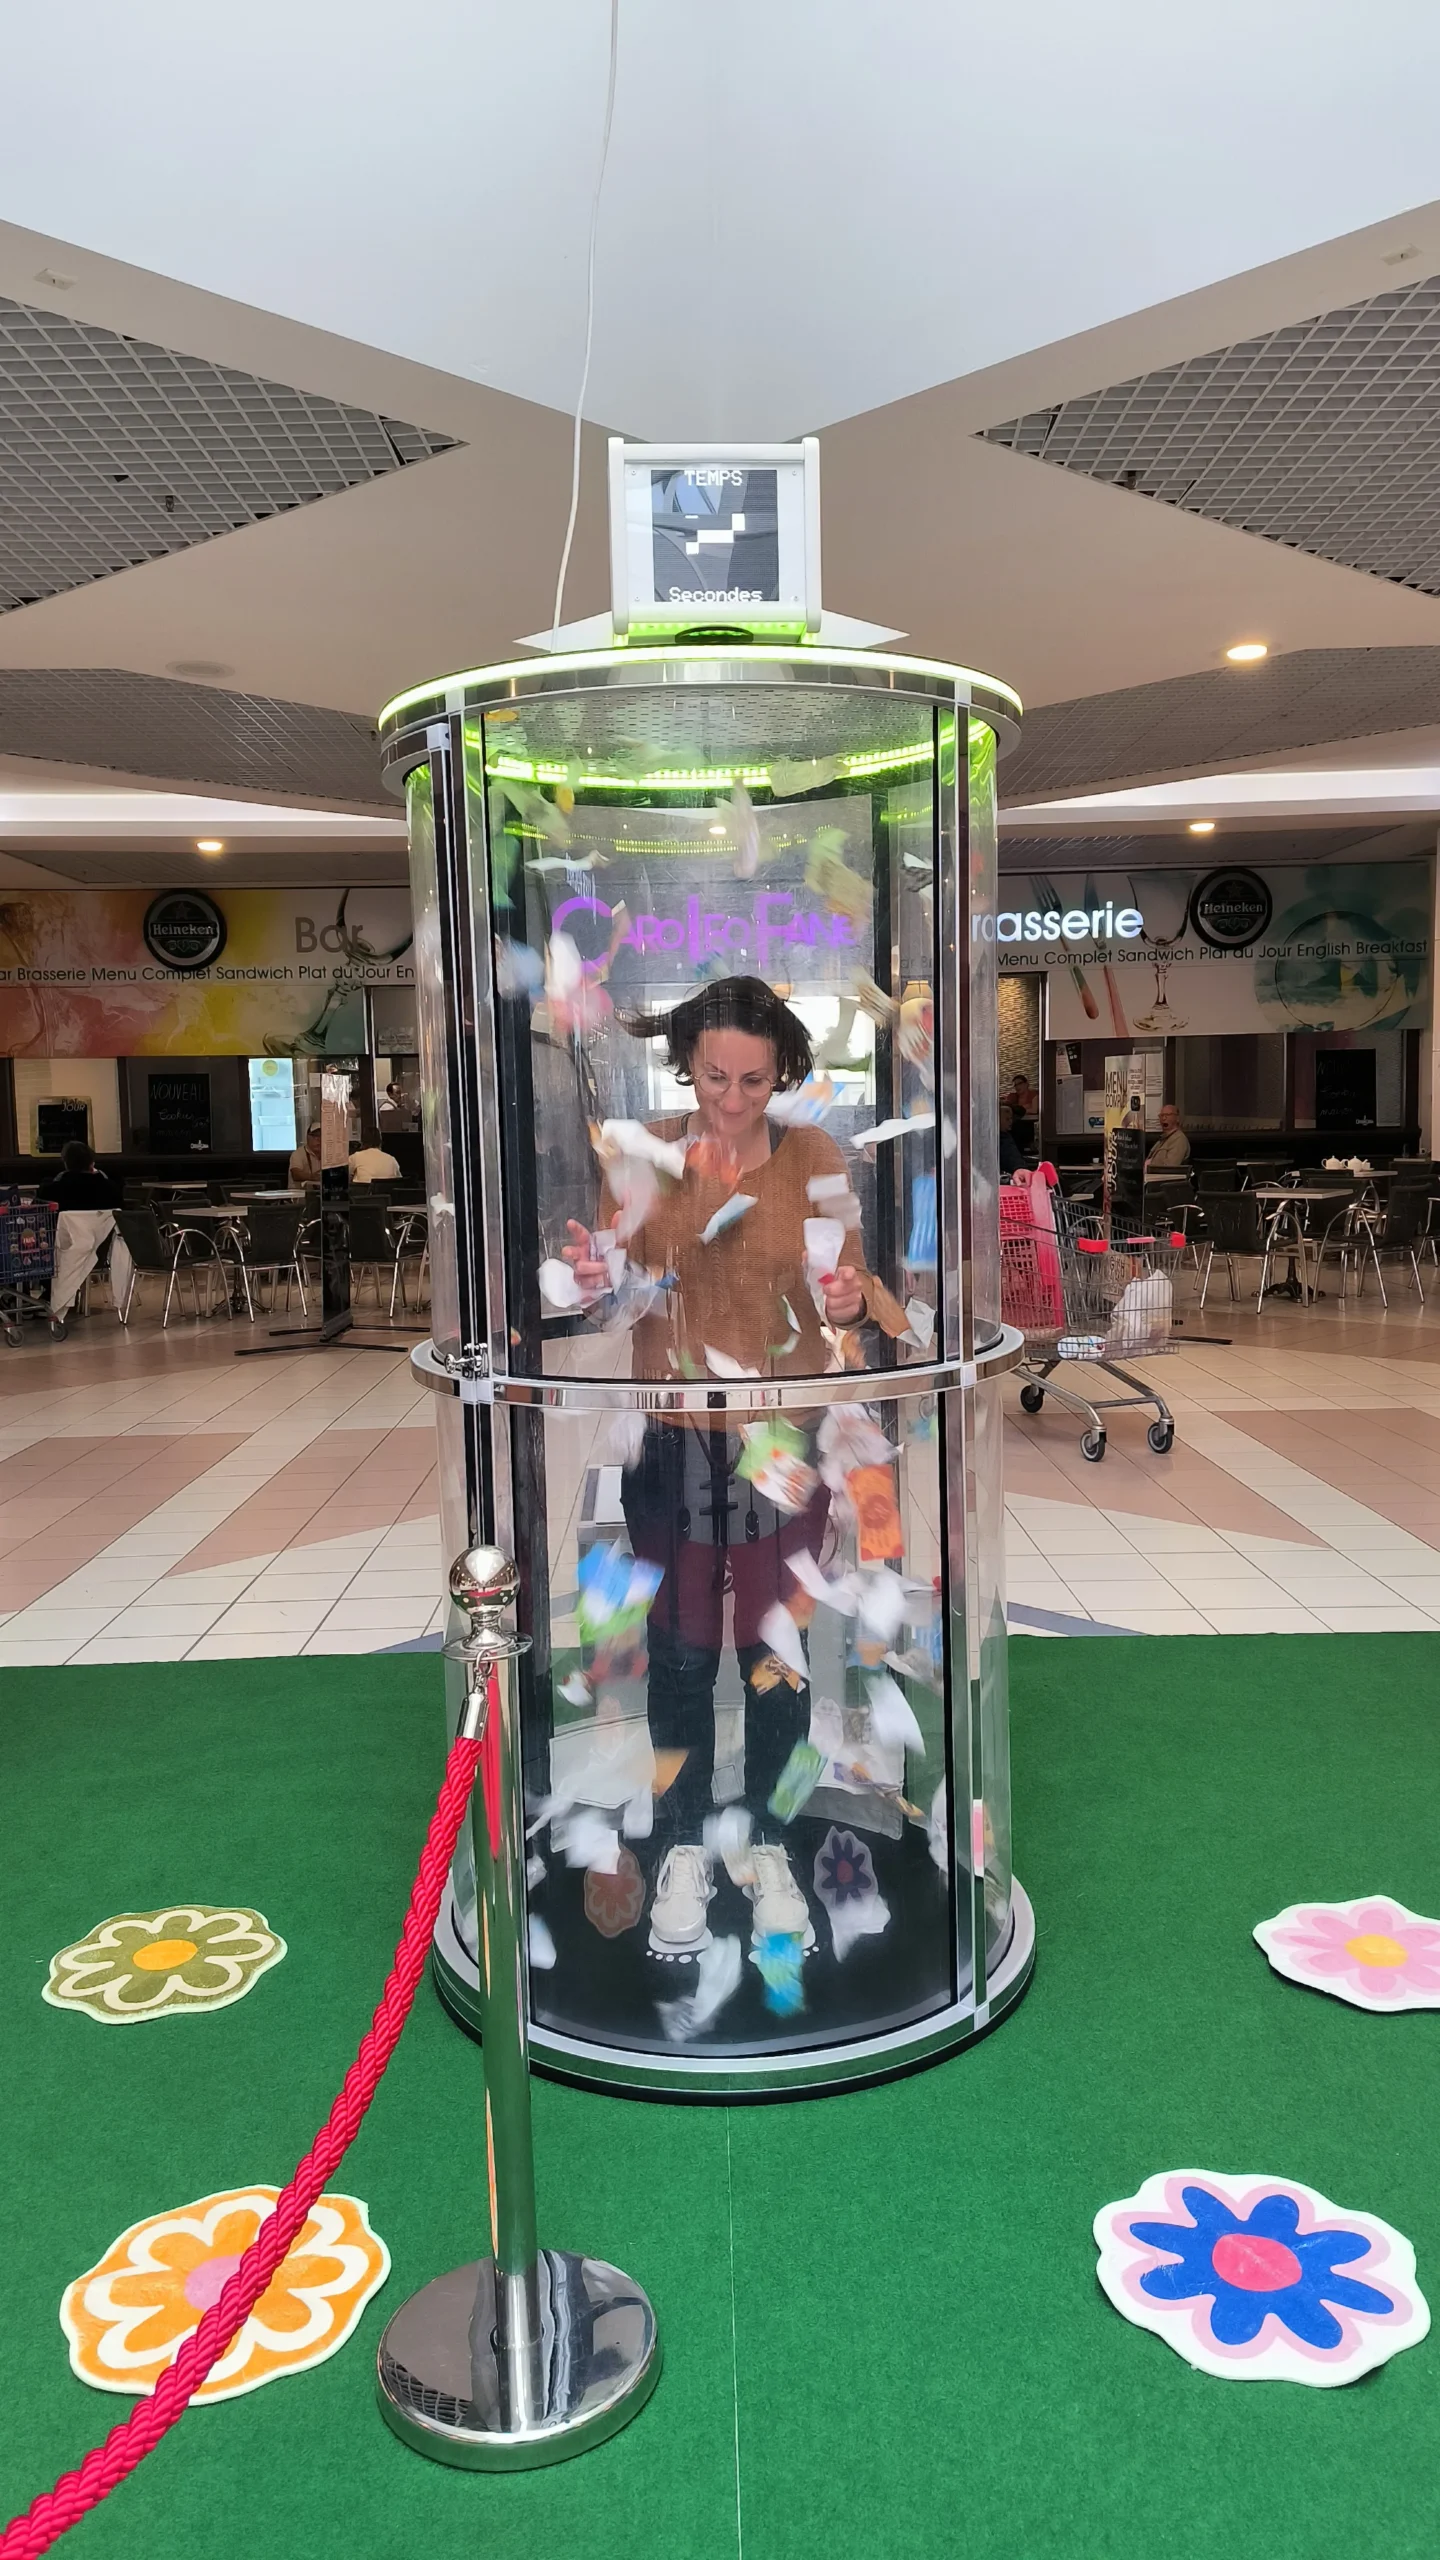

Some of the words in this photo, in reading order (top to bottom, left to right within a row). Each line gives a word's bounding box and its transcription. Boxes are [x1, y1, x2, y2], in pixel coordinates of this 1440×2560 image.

[684, 470, 743, 486] TEMPS
[668, 586, 764, 602] Secondes
[1203, 902, 1264, 915] Heineken
[153, 923, 214, 936] Heineken
[294, 917, 363, 954] Bar
[1045, 950, 1112, 966] Complet
[1117, 946, 1194, 963] Sandwich
[1258, 945, 1292, 958] Jour
[1297, 942, 1351, 959] English
[1356, 940, 1428, 955] Breakfast
[17, 967, 86, 981] Brasserie
[92, 967, 137, 980] Menu
[142, 967, 211, 983] Complet
[216, 966, 293, 980] Sandwich
[298, 966, 327, 980] Plat
[332, 966, 353, 979] du
[358, 966, 391, 979] Jour
[1105, 1071, 1128, 1093] MENU
[61, 1102, 86, 1112] JOUR
